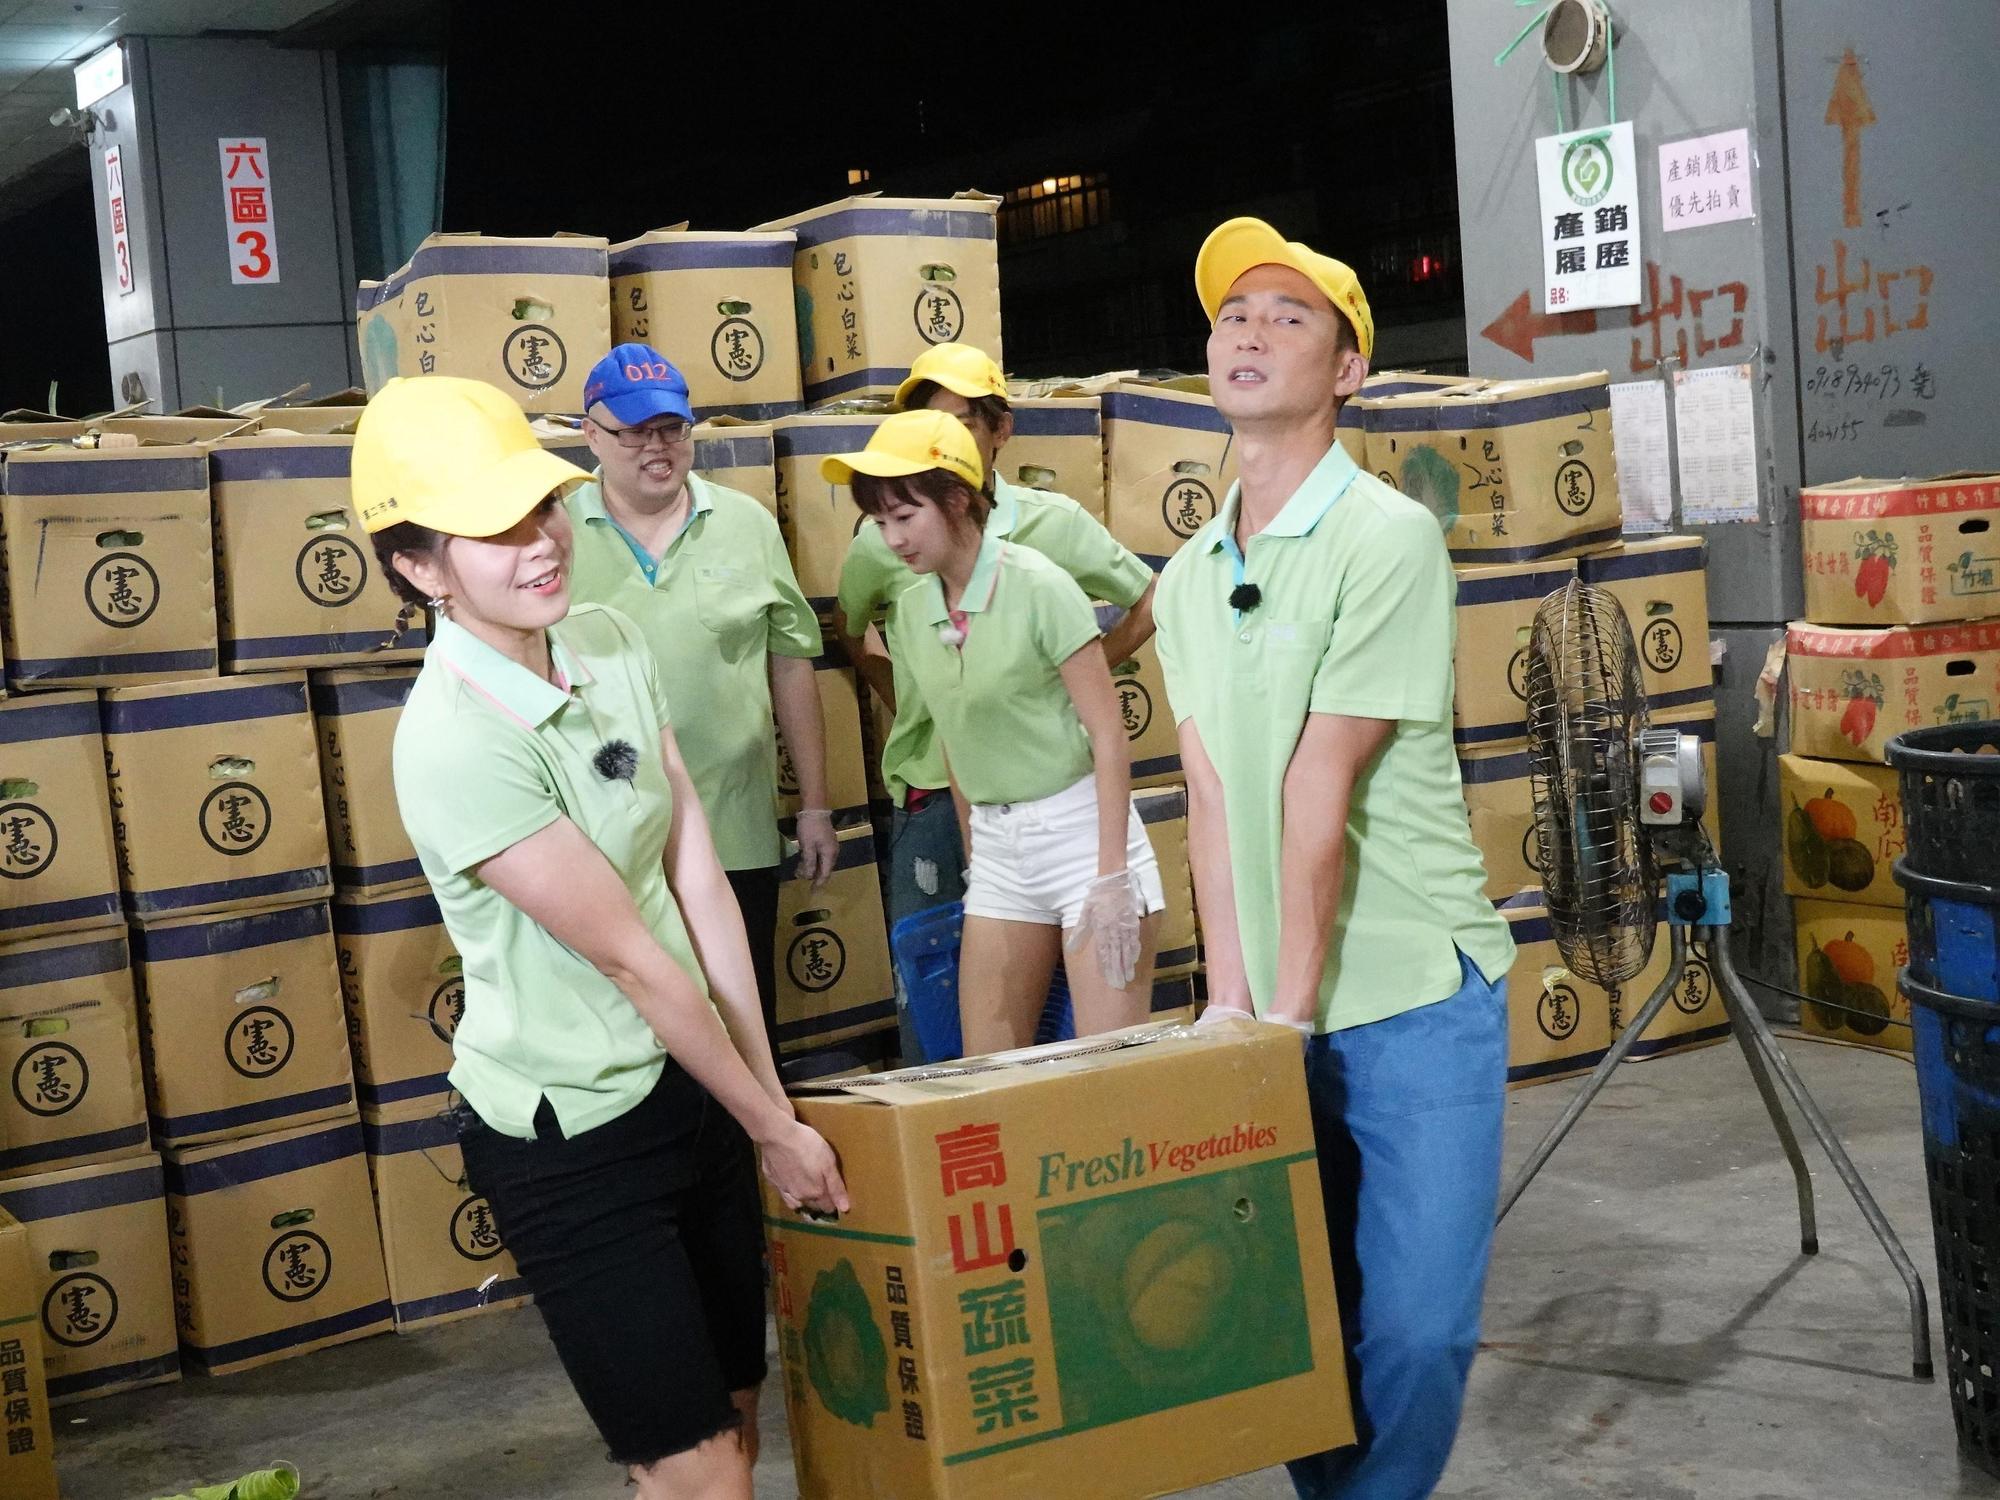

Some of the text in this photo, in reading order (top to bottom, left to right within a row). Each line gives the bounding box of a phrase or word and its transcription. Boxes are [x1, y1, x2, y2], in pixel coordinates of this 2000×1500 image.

[1667, 147, 1740, 183] 產銷履歷
[226, 143, 271, 278] 六區3
[1553, 205, 1628, 240] 產銷
[1669, 184, 1741, 218] 優先拍賣
[1555, 240, 1630, 275] 履歷
[833, 252, 862, 360] 包心白菜
[1815, 239, 1934, 353] 出口
[625, 362, 671, 381] 012
[725, 328, 753, 371] 憲
[1177, 488, 1203, 530] 憲
[1483, 440, 1509, 537] 包心白菜
[105, 565, 142, 616] 憲
[315, 546, 350, 595] 憲
[328, 731, 355, 852] 包心白菜
[1, 816, 41, 867] 憲
[219, 795, 255, 843] 憲
[801, 940, 833, 982] 憲
[243, 1018, 278, 1067] 憲
[33, 1055, 71, 1103] 憲
[1035, 1121, 1278, 1199] Fresh Vegetables
[280, 1243, 317, 1290] 憲
[935, 1124, 1040, 1435] 高山蔬菜
[61, 1286, 101, 1335] 憲
[0, 1338, 36, 1456] 品質保證
